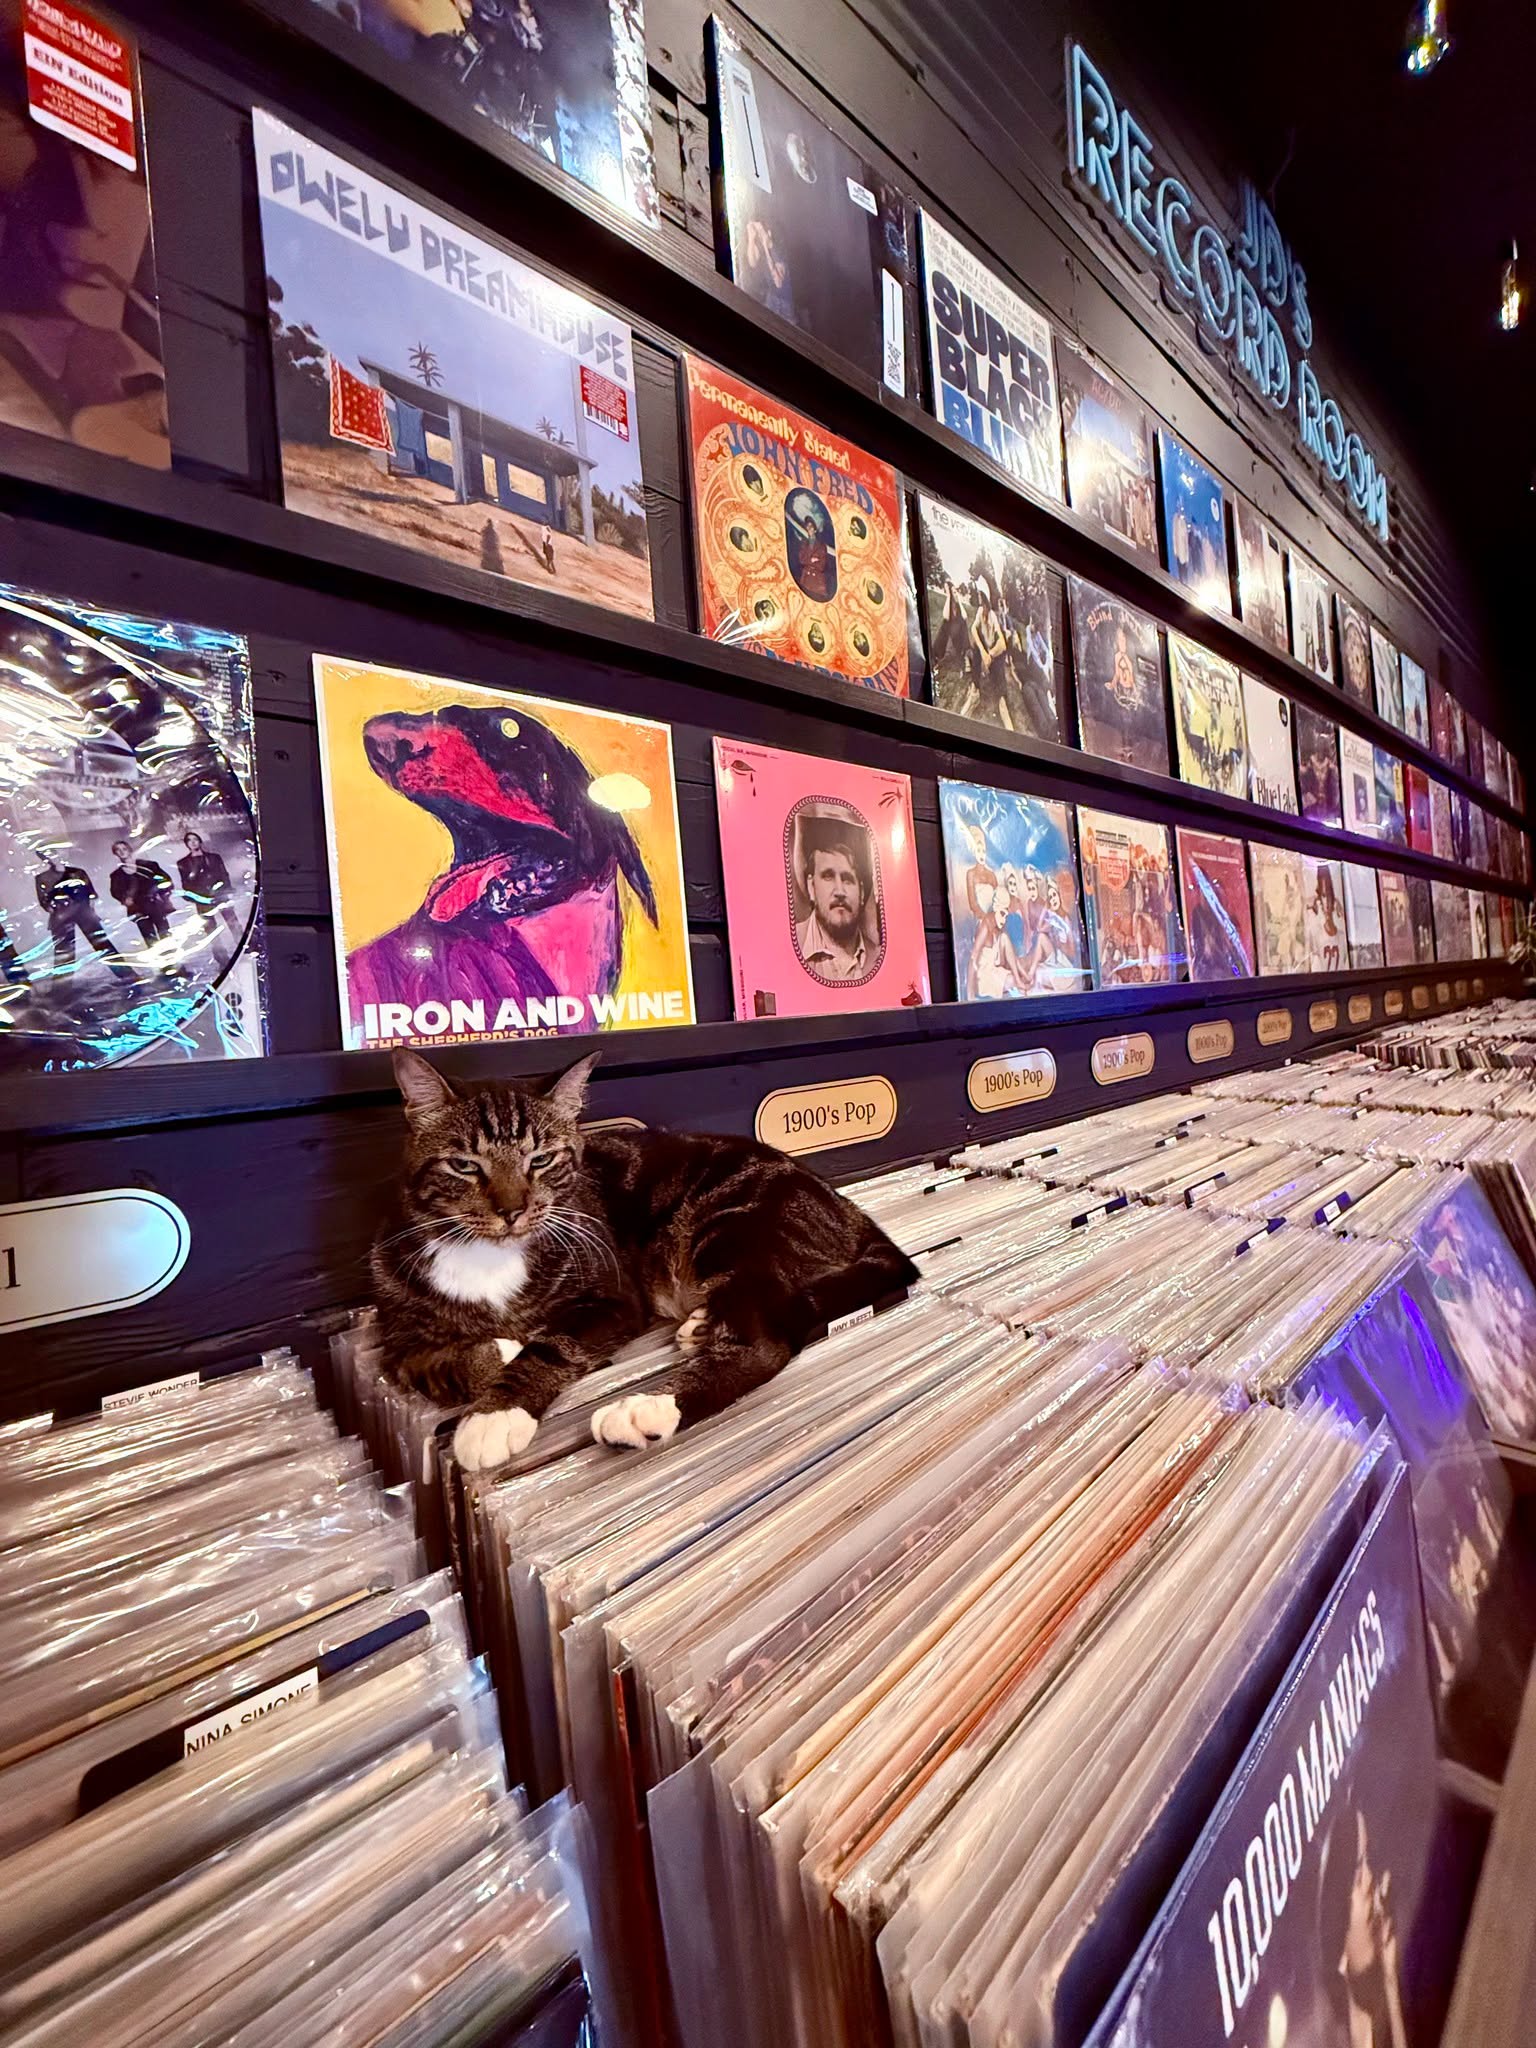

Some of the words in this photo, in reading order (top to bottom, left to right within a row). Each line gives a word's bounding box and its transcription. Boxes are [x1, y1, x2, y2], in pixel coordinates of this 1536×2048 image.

[1068, 40, 1290, 409] RECORD
[1298, 360, 1389, 541] ROOM
[931, 270, 1051, 409] SUPER
[935, 322, 1053, 446] BLACK
[725, 422, 803, 484] JOHN
[807, 458, 875, 515] FRED
[363, 998, 486, 1040] IRON
[491, 994, 585, 1030] AND
[588, 990, 685, 1024] WINE
[366, 1037, 403, 1050] THE
[984, 1072, 1021, 1093] 1900's
[1022, 1068, 1044, 1088] Pop
[1102, 1049, 1129, 1068] 1900's
[1130, 1048, 1146, 1066] Pop
[782, 1105, 840, 1134] 1900's
[844, 1101, 877, 1125] Pop
[103, 1392, 145, 1410] STEVIE
[148, 1378, 198, 1398] WONDER
[186, 1723, 233, 1758] NINA
[240, 1683, 312, 1726] SIMO
[1207, 1772, 1304, 2039] 10,000
[1297, 1588, 1387, 1843] MANIACS
